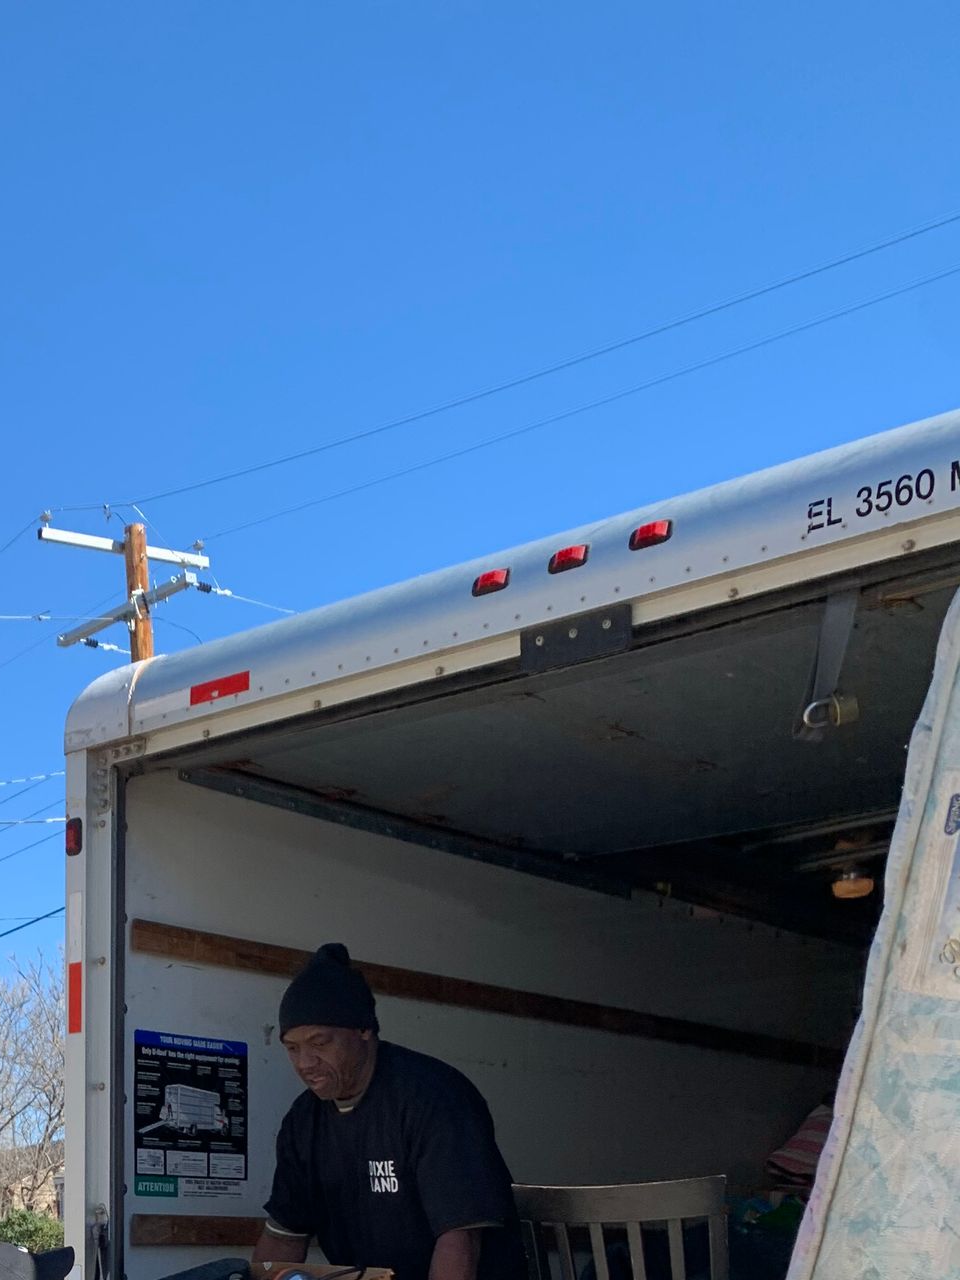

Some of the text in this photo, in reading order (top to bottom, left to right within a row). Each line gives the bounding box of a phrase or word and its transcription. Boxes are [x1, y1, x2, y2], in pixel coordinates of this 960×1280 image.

[807, 497, 843, 534] EL
[855, 468, 935, 518] 3560
[137, 1181, 175, 1193] ATTENTION
